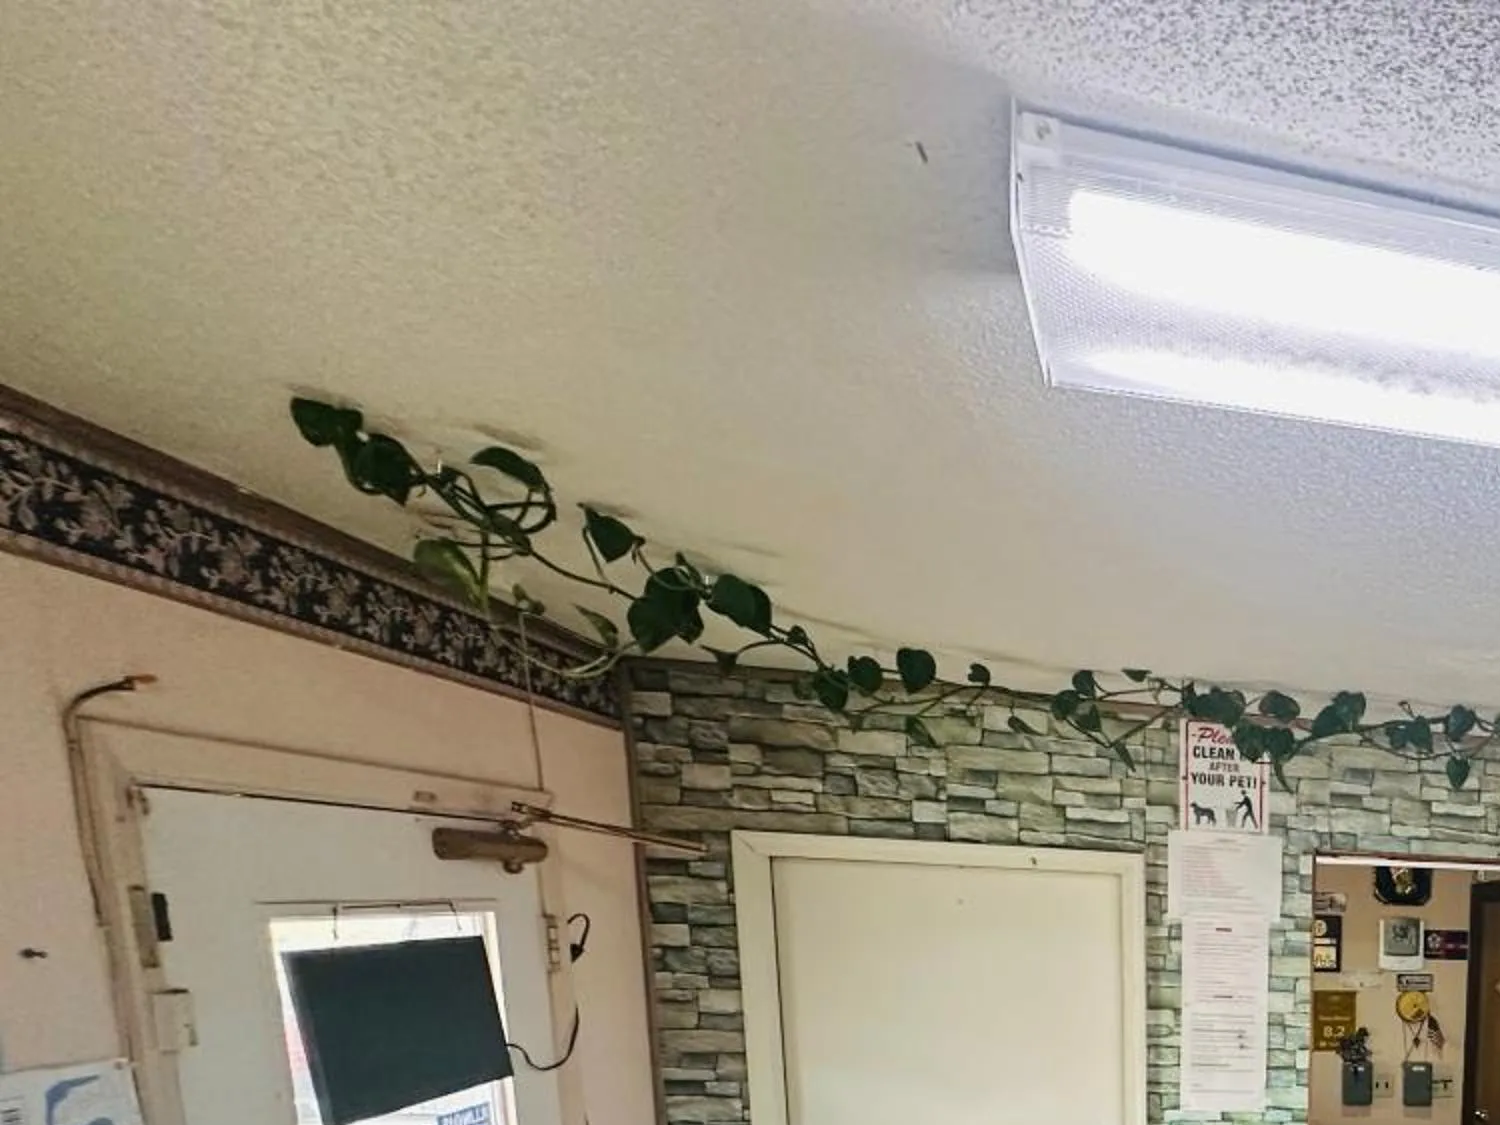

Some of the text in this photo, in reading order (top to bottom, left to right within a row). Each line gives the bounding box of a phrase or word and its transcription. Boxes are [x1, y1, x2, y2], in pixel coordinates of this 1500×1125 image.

[1193, 745, 1235, 760] CLEAN
[1209, 761, 1240, 773] AFTER
[1191, 771, 1225, 788] YOUR
